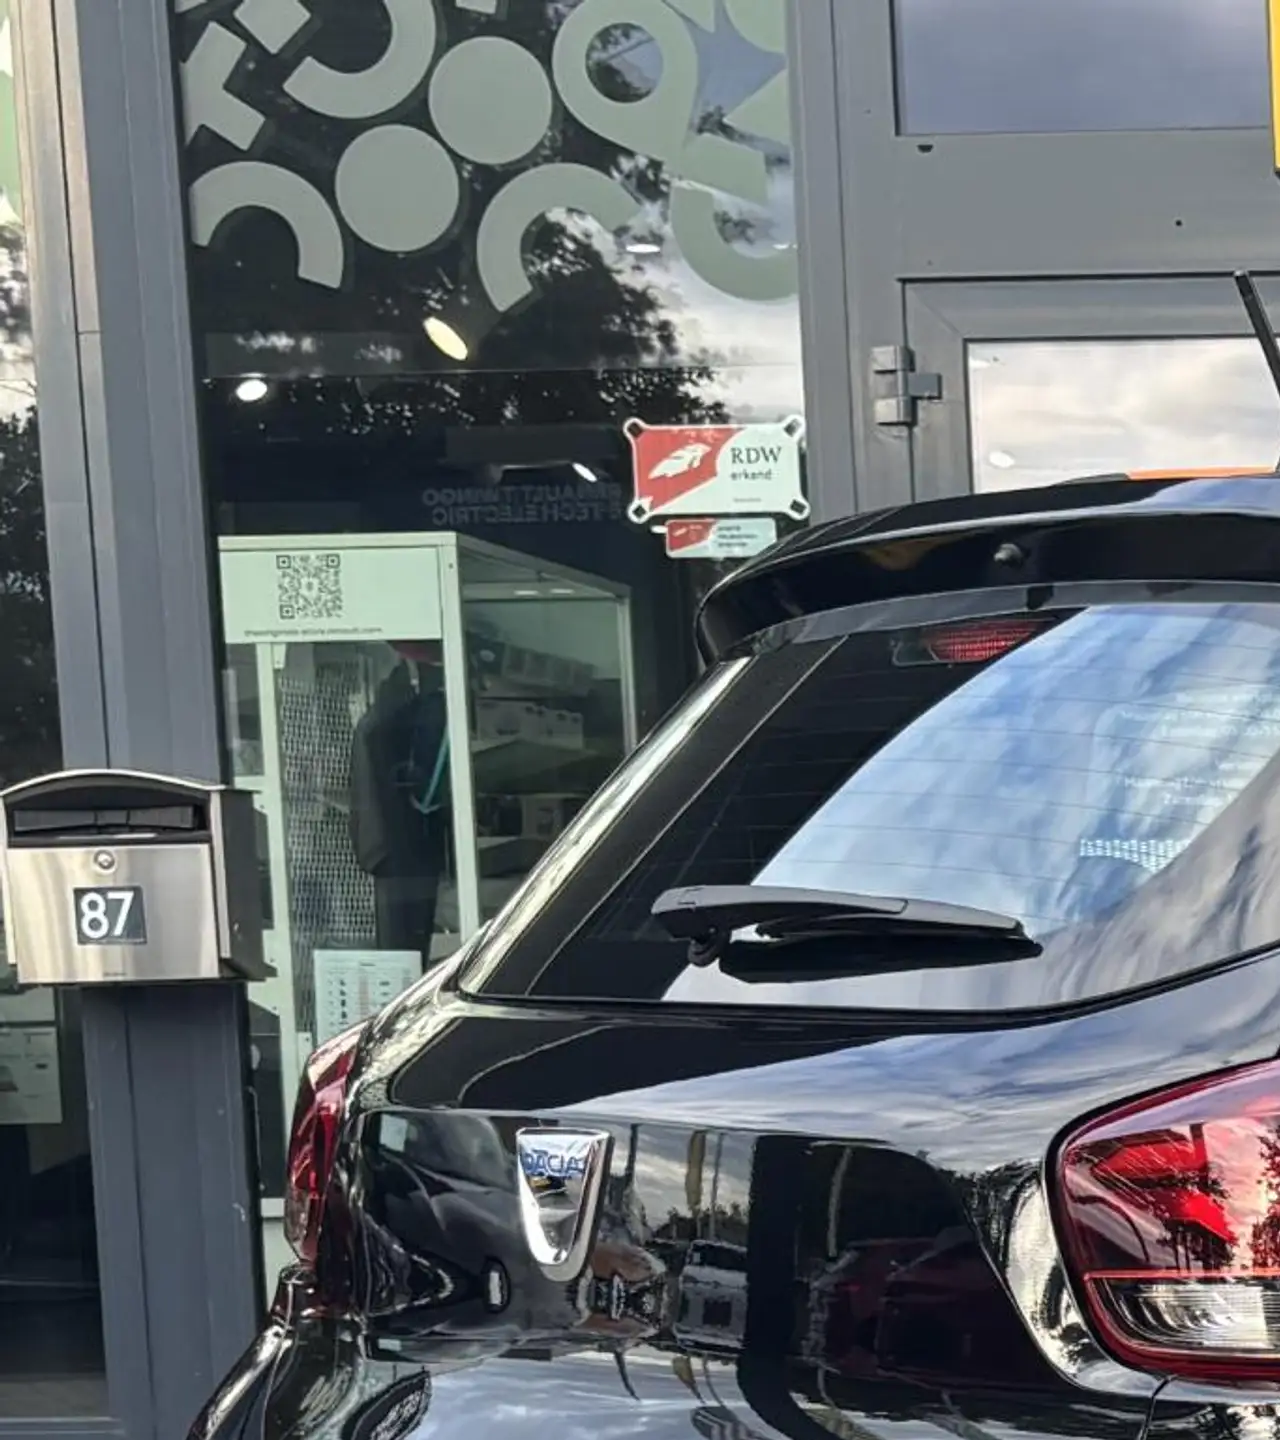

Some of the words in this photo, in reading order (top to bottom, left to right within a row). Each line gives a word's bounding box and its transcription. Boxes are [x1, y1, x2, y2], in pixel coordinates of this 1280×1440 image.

[730, 446, 782, 465] RDW
[730, 469, 772, 481] erkend
[80, 891, 134, 938] 87
